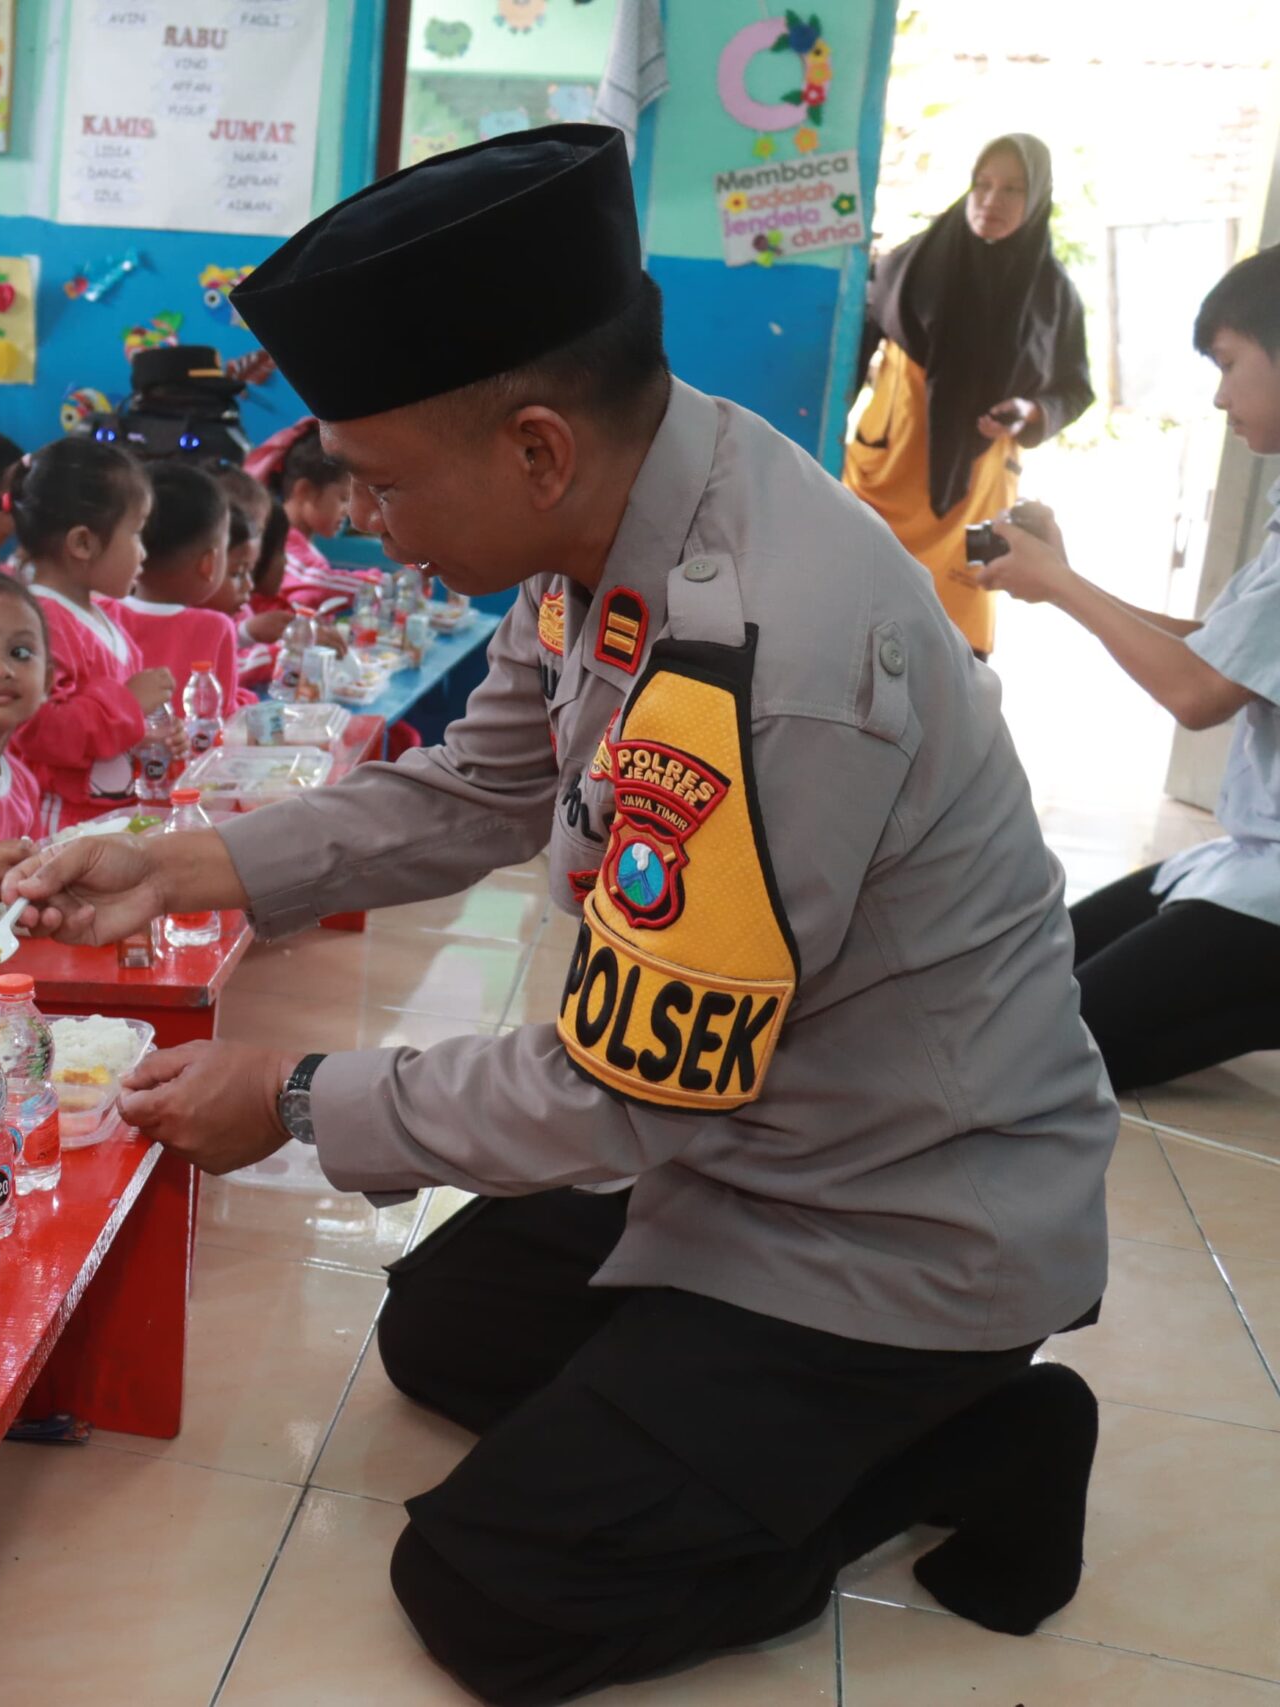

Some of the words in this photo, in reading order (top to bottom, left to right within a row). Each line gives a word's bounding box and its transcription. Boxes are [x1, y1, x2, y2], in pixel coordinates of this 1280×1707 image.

[163, 25, 229, 50] RABU
[81, 114, 156, 139] KAMIS
[208, 118, 297, 145] JUM'AT
[716, 156, 849, 193] Membaca
[748, 181, 835, 210] adalah
[791, 217, 861, 248] dunia
[617, 748, 716, 803] POLRES
[624, 765, 699, 807] JEMBER
[622, 795, 653, 811] JAWA
[655, 802, 689, 831] TIMUR
[560, 922, 779, 1095] POLSEK
